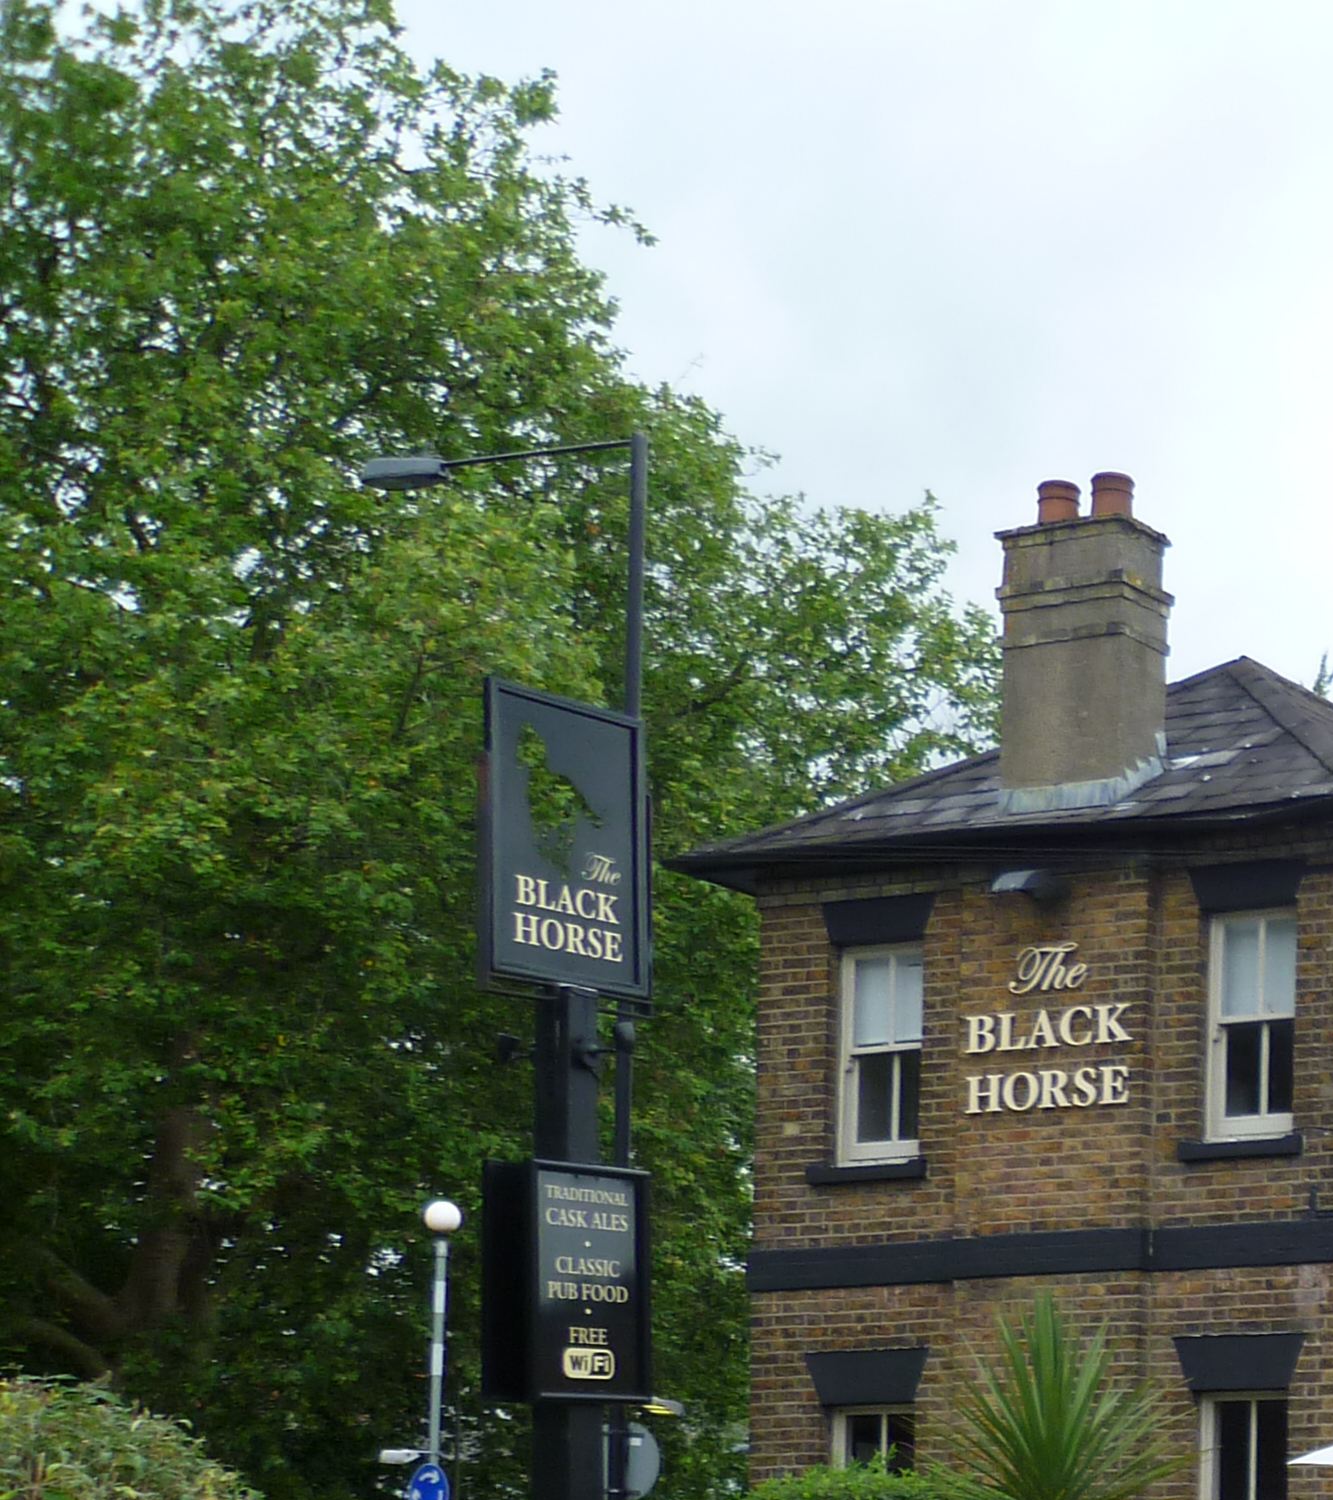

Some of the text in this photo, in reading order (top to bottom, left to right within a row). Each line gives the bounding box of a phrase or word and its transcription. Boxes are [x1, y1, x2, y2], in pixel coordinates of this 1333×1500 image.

[581, 852, 622, 885] The
[515, 874, 620, 925] BLACK
[513, 912, 623, 962] HORSE
[1009, 942, 1089, 994] The
[964, 1003, 1134, 1055] BLACK
[964, 1066, 1130, 1114] HORSE
[544, 1184, 629, 1207] TRADITIONAL
[545, 1207, 629, 1232] CASK ALES
[555, 1256, 621, 1278] CLASSIC
[547, 1281, 629, 1304] PUB FOOD
[568, 1326, 609, 1346] FREE
